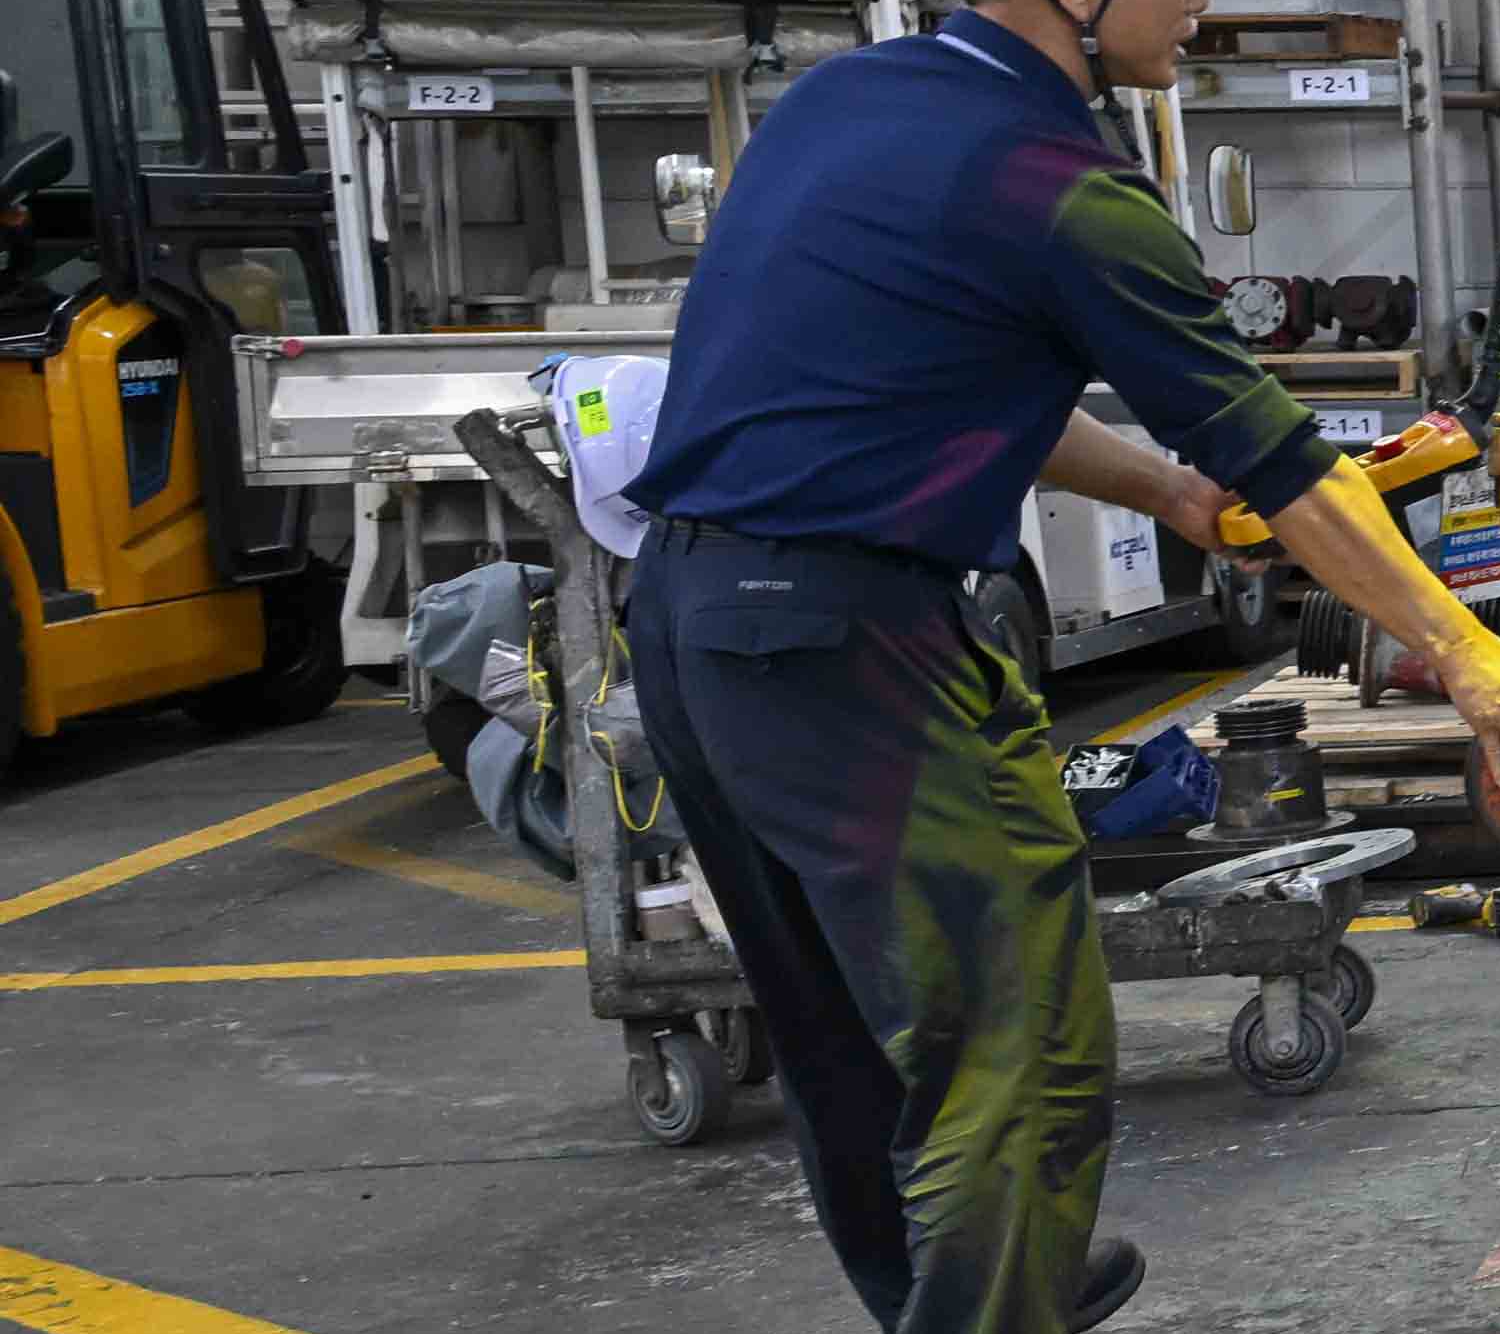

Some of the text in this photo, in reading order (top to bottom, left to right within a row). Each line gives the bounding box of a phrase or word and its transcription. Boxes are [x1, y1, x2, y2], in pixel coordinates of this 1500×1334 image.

[420, 83, 484, 107] F-2-2
[1301, 74, 1357, 98] F-2-1
[119, 358, 178, 379] HYUNDAI
[1319, 418, 1369, 435] F-1-1
